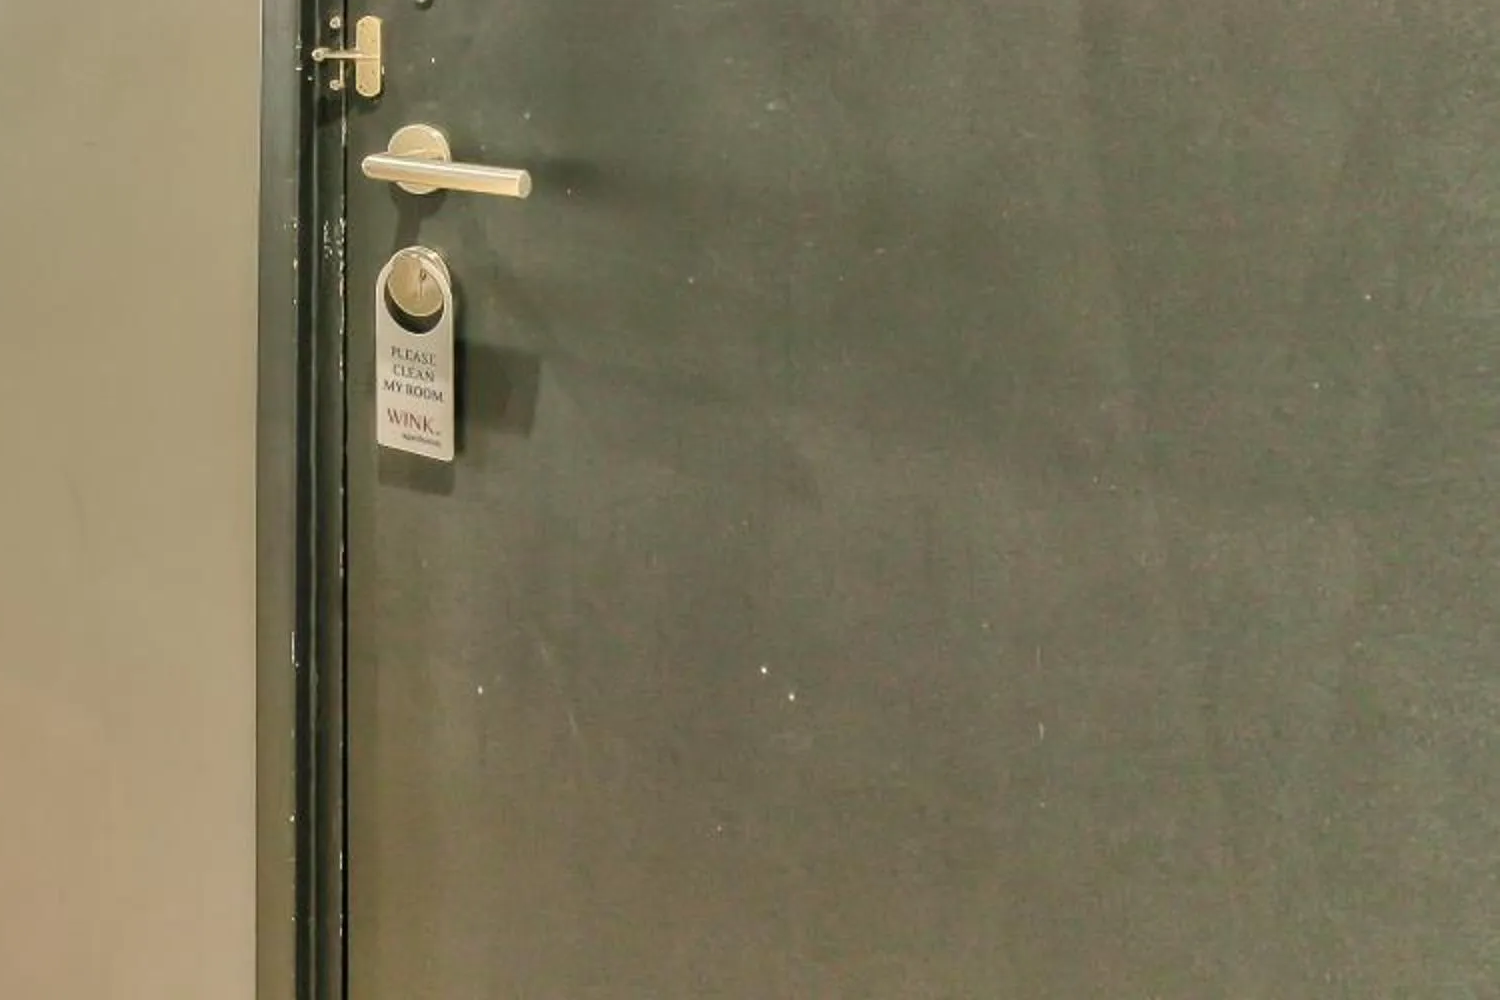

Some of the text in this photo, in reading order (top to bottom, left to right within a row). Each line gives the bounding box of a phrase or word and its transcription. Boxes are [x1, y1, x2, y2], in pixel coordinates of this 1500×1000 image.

[390, 345, 437, 367] PLEASE
[392, 364, 436, 384] CLEAN
[382, 379, 445, 403] MY ROOM
